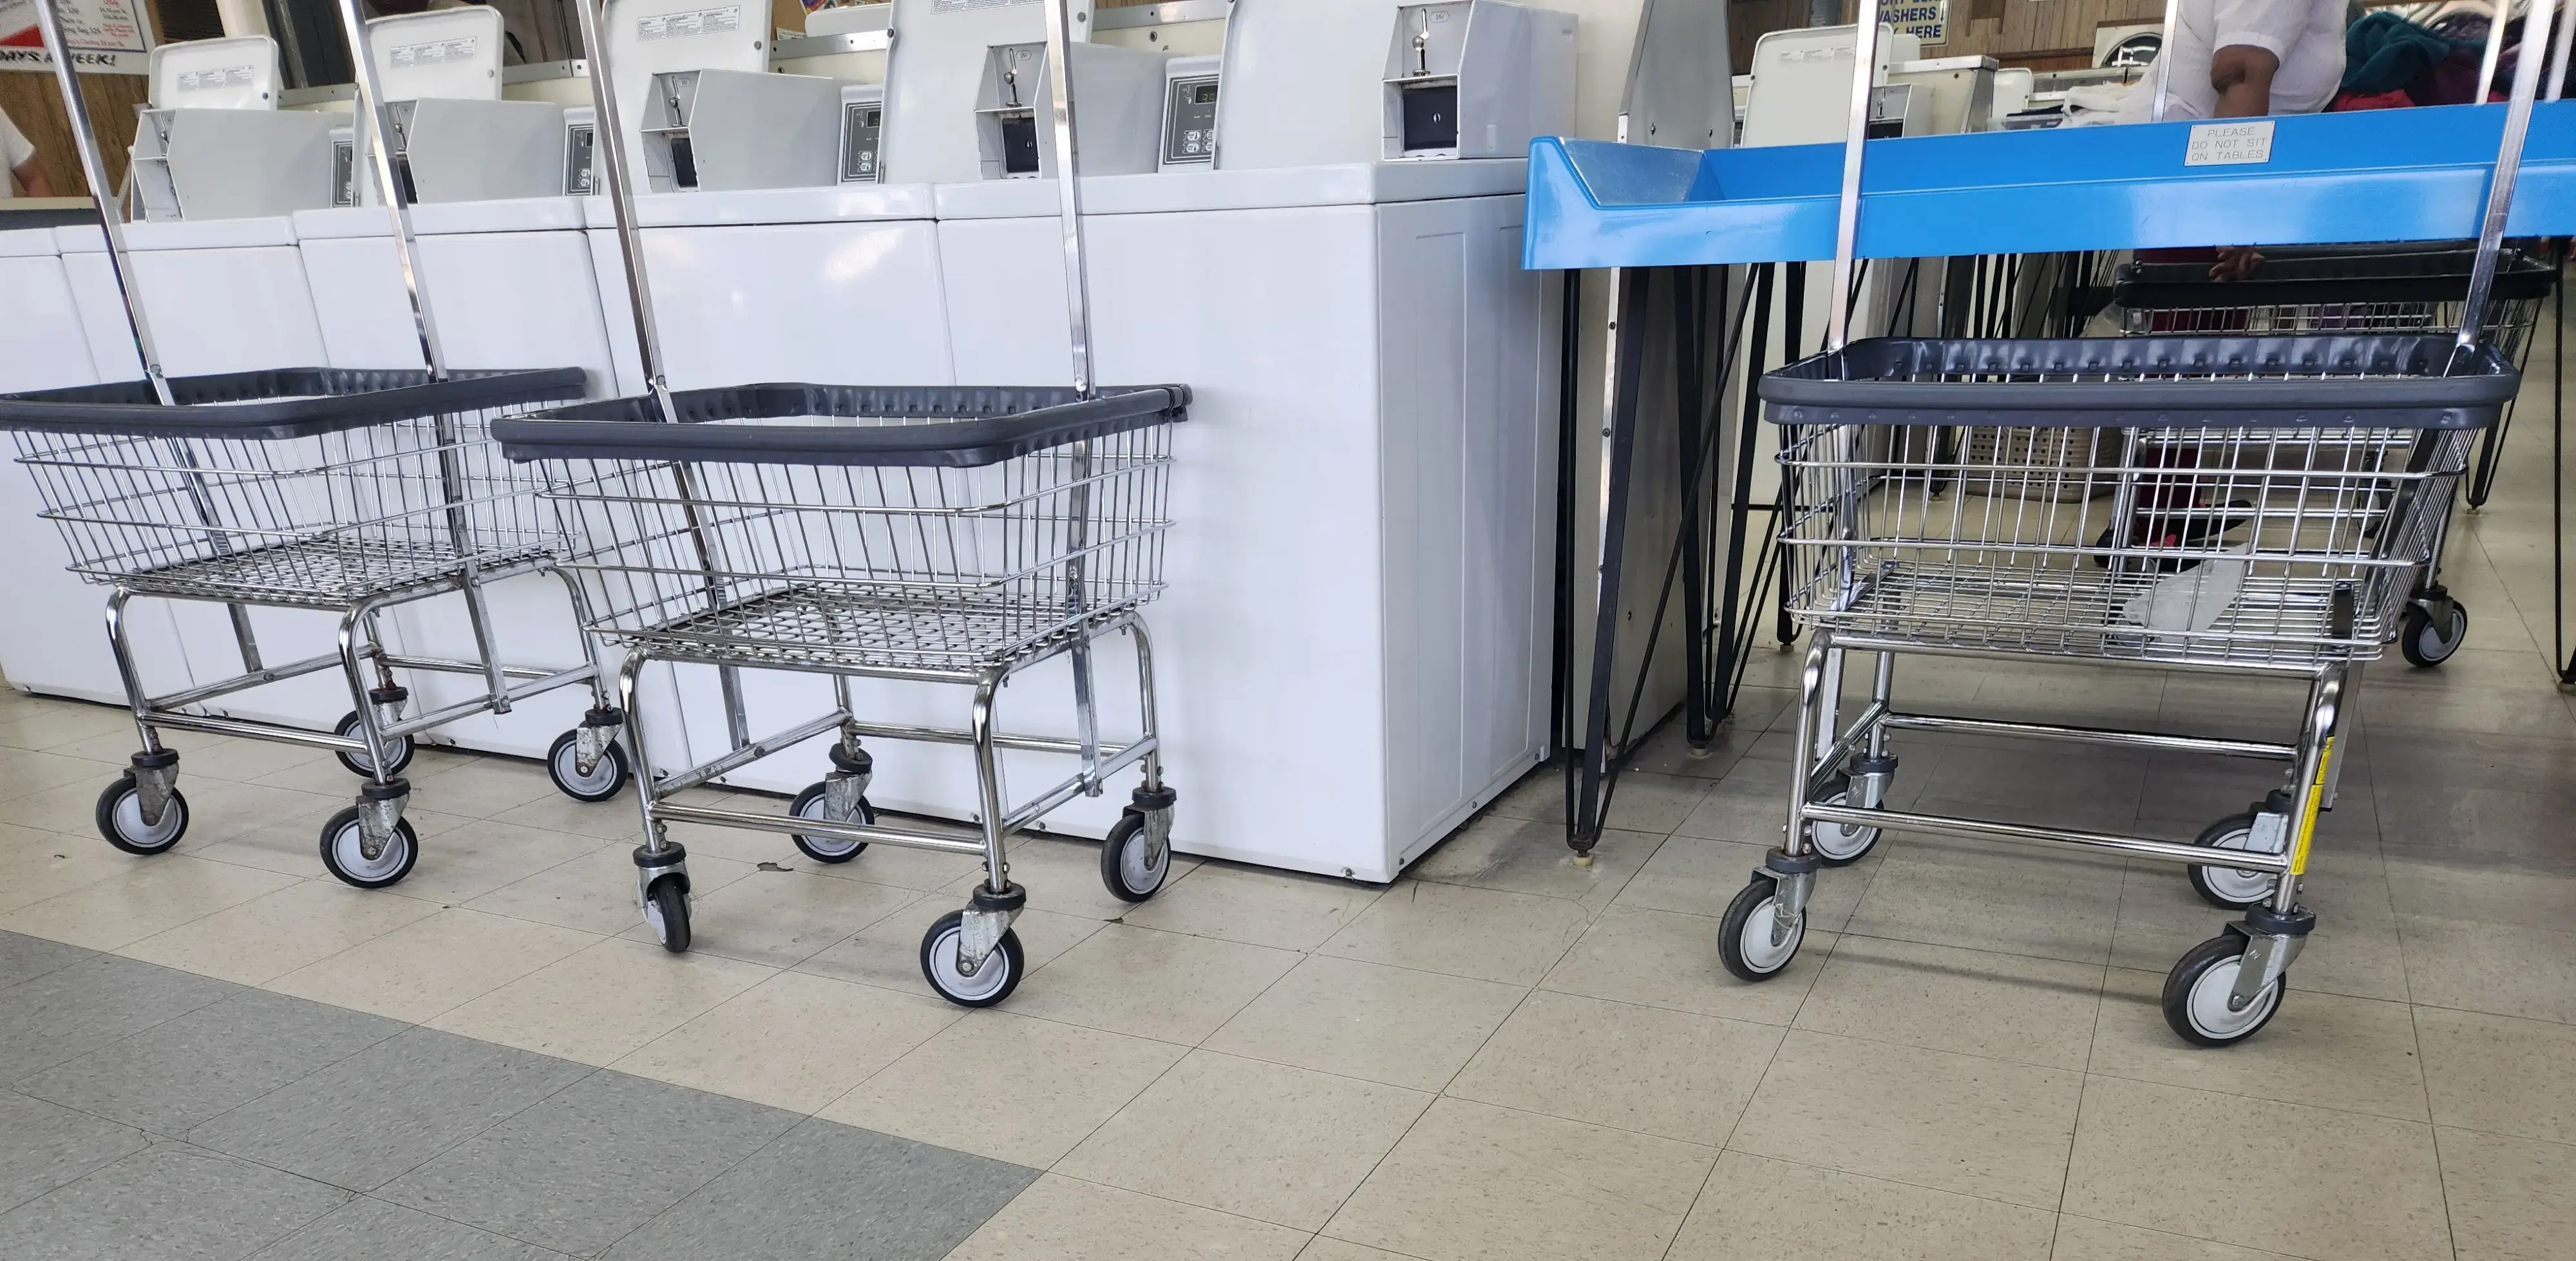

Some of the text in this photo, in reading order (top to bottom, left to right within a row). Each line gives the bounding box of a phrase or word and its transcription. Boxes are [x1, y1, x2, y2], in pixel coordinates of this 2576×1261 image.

[1880, 6, 1937, 23] ASHERS
[71, 53, 116, 66] EEK!
[2207, 127, 2255, 137] PLEASE
[2192, 138, 2268, 149] DO NOT SIT
[2192, 150, 2264, 161] ON TABLES
